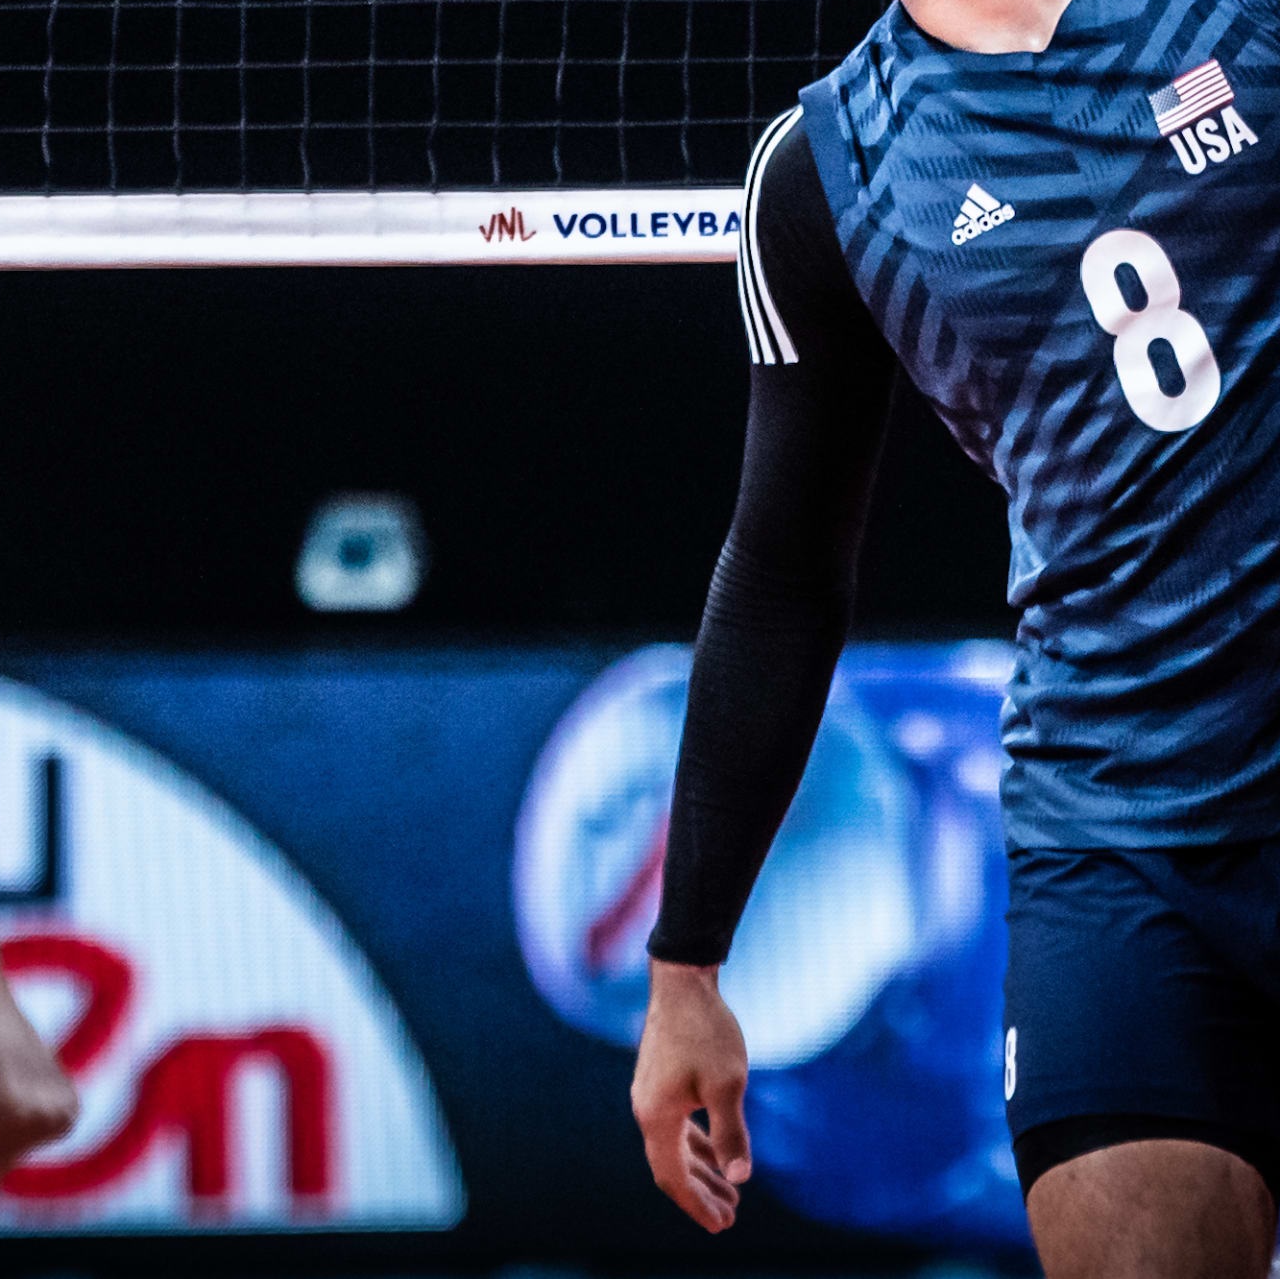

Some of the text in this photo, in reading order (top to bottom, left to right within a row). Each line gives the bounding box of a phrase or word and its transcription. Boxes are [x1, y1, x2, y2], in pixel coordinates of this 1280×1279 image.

[1170, 106, 1259, 175] USA
[478, 207, 537, 243] VNL
[951, 203, 1016, 246] adidas
[1080, 228, 1221, 433] 8
